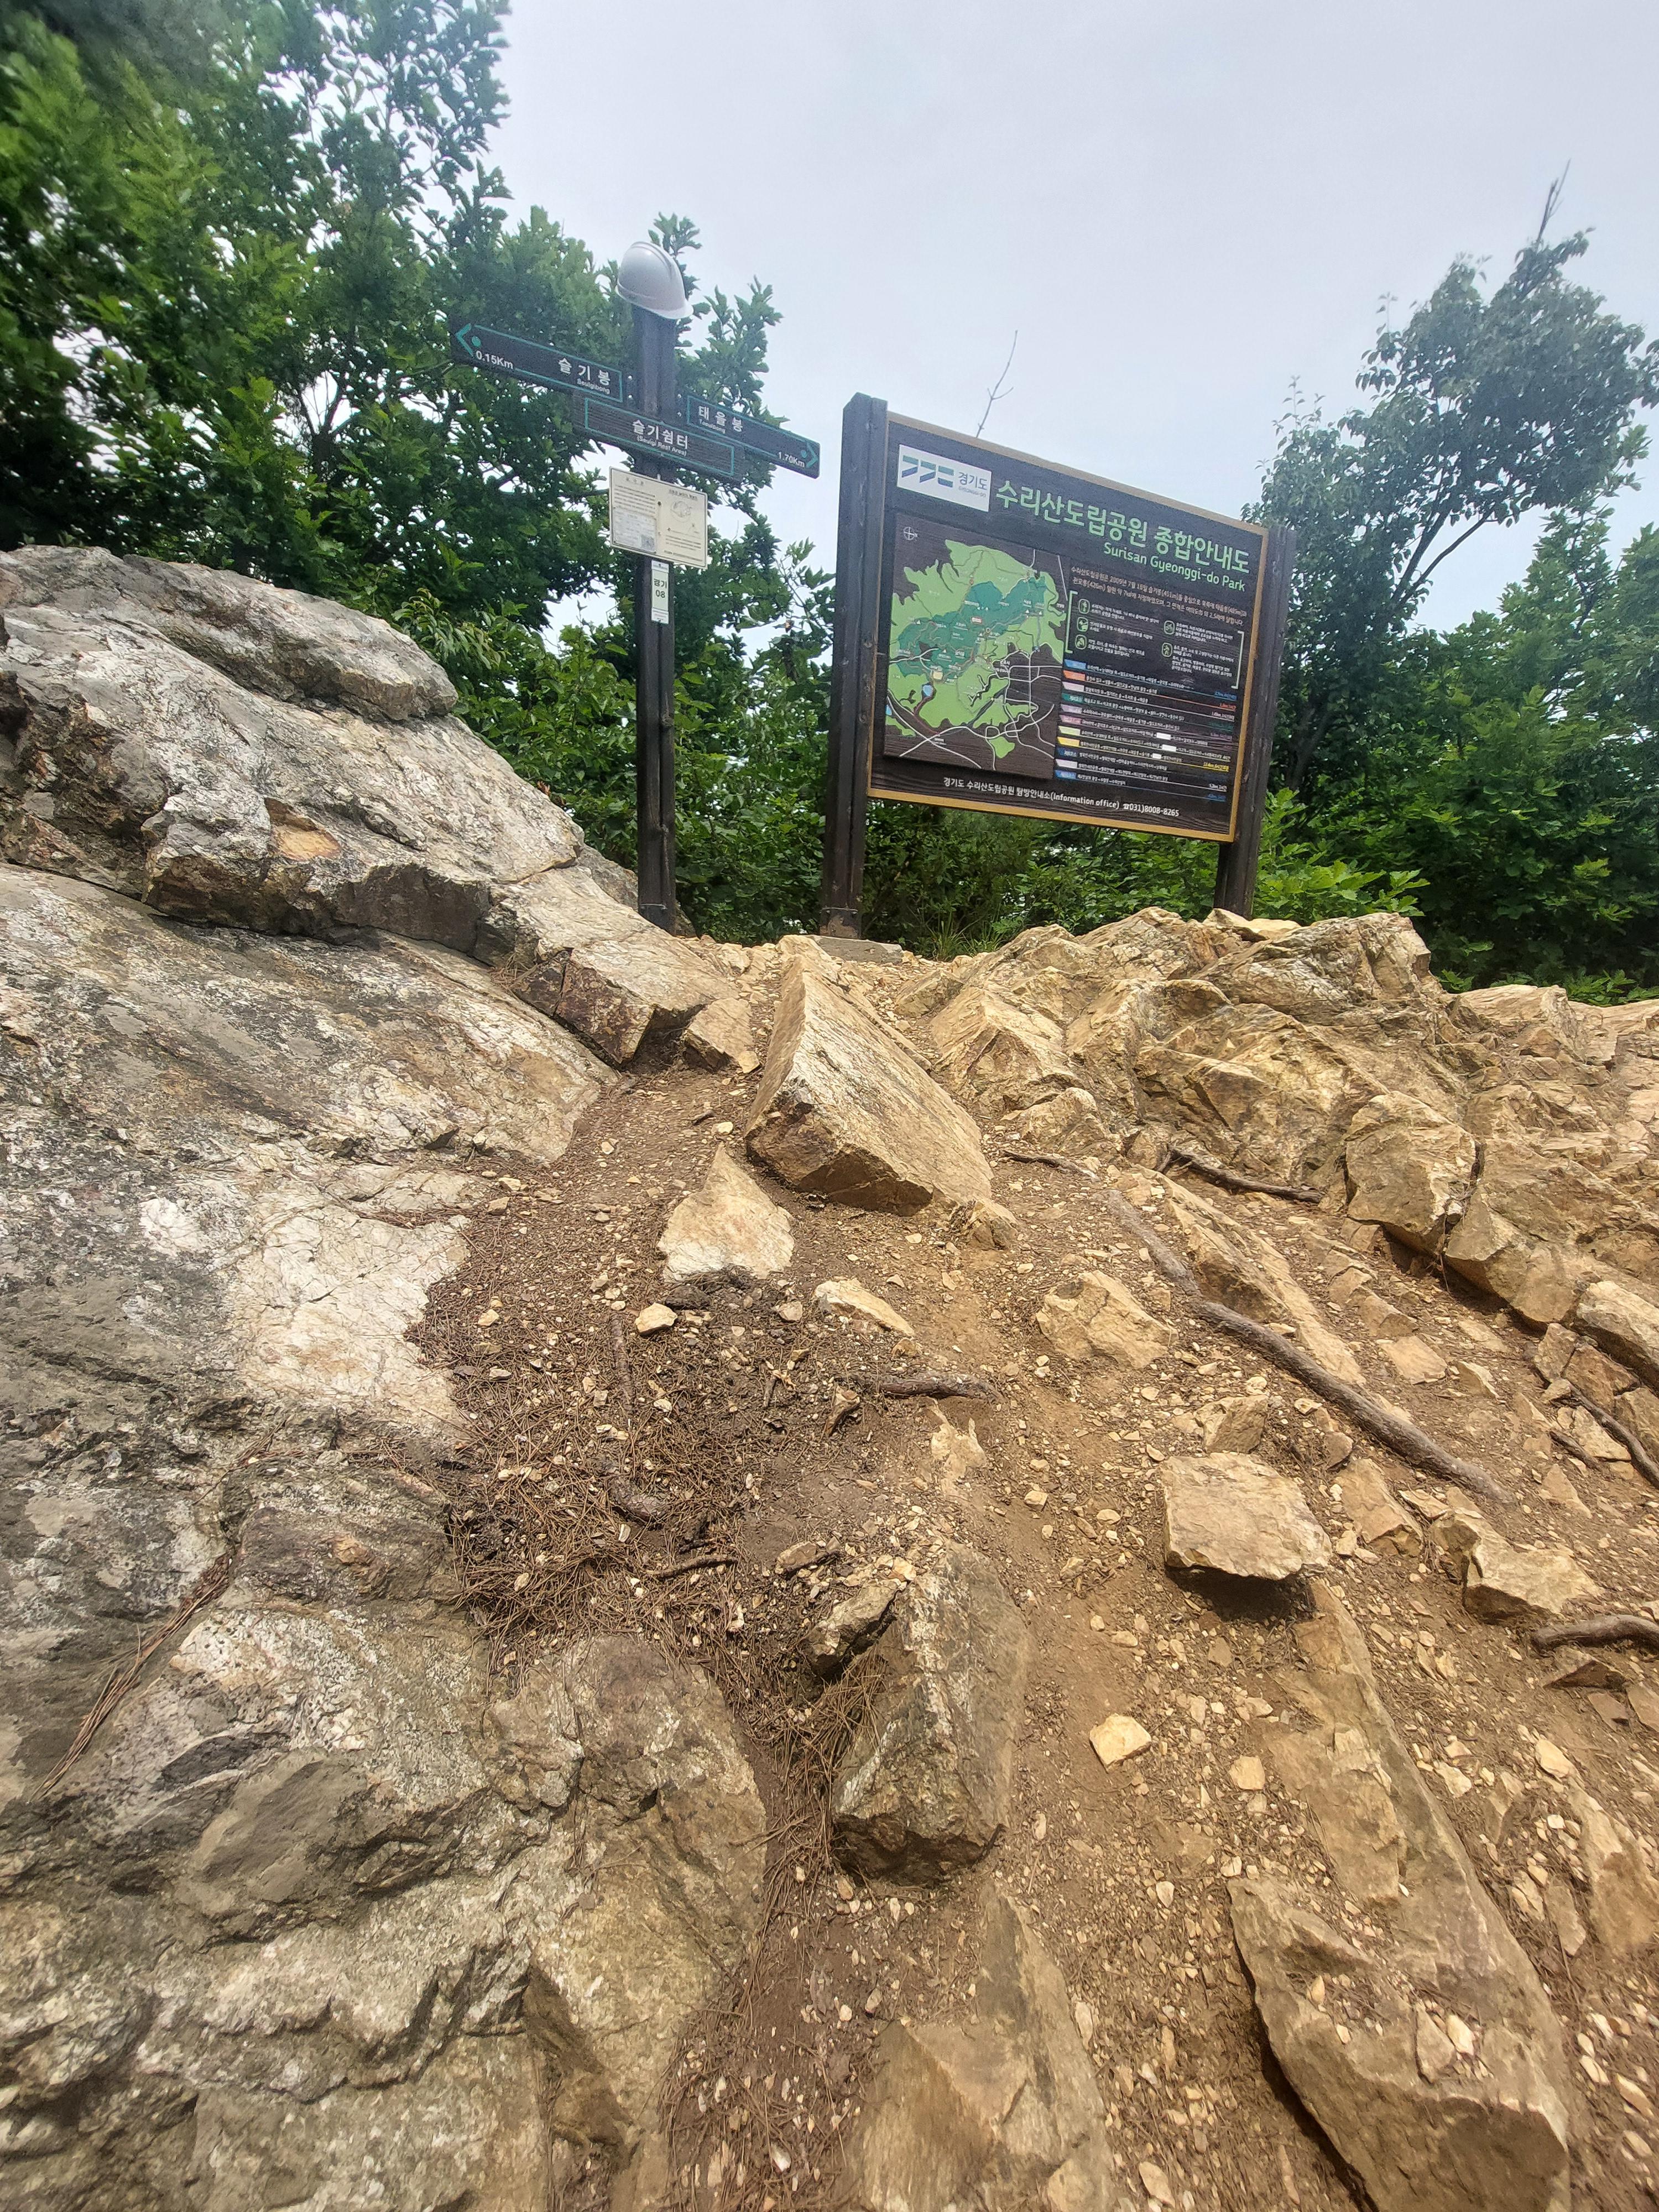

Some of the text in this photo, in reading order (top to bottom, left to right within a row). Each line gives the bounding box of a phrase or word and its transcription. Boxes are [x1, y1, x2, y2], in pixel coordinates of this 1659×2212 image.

[476, 350, 514, 370] 0.15Km
[632, 420, 688, 450] 슬기쉼터
[778, 451, 806, 468] 1.70Km
[958, 471, 988, 491] 경기도
[996, 480, 1250, 573] 수리산도립공원 종합안내도
[1104, 541, 1246, 592] Surisan Gyeonggi-do Park
[655, 589, 665, 598] 08
[943, 777, 964, 787] 경기도
[966, 780, 1015, 795] 수리산도립공원
[1095, 799, 1120, 810] office)
